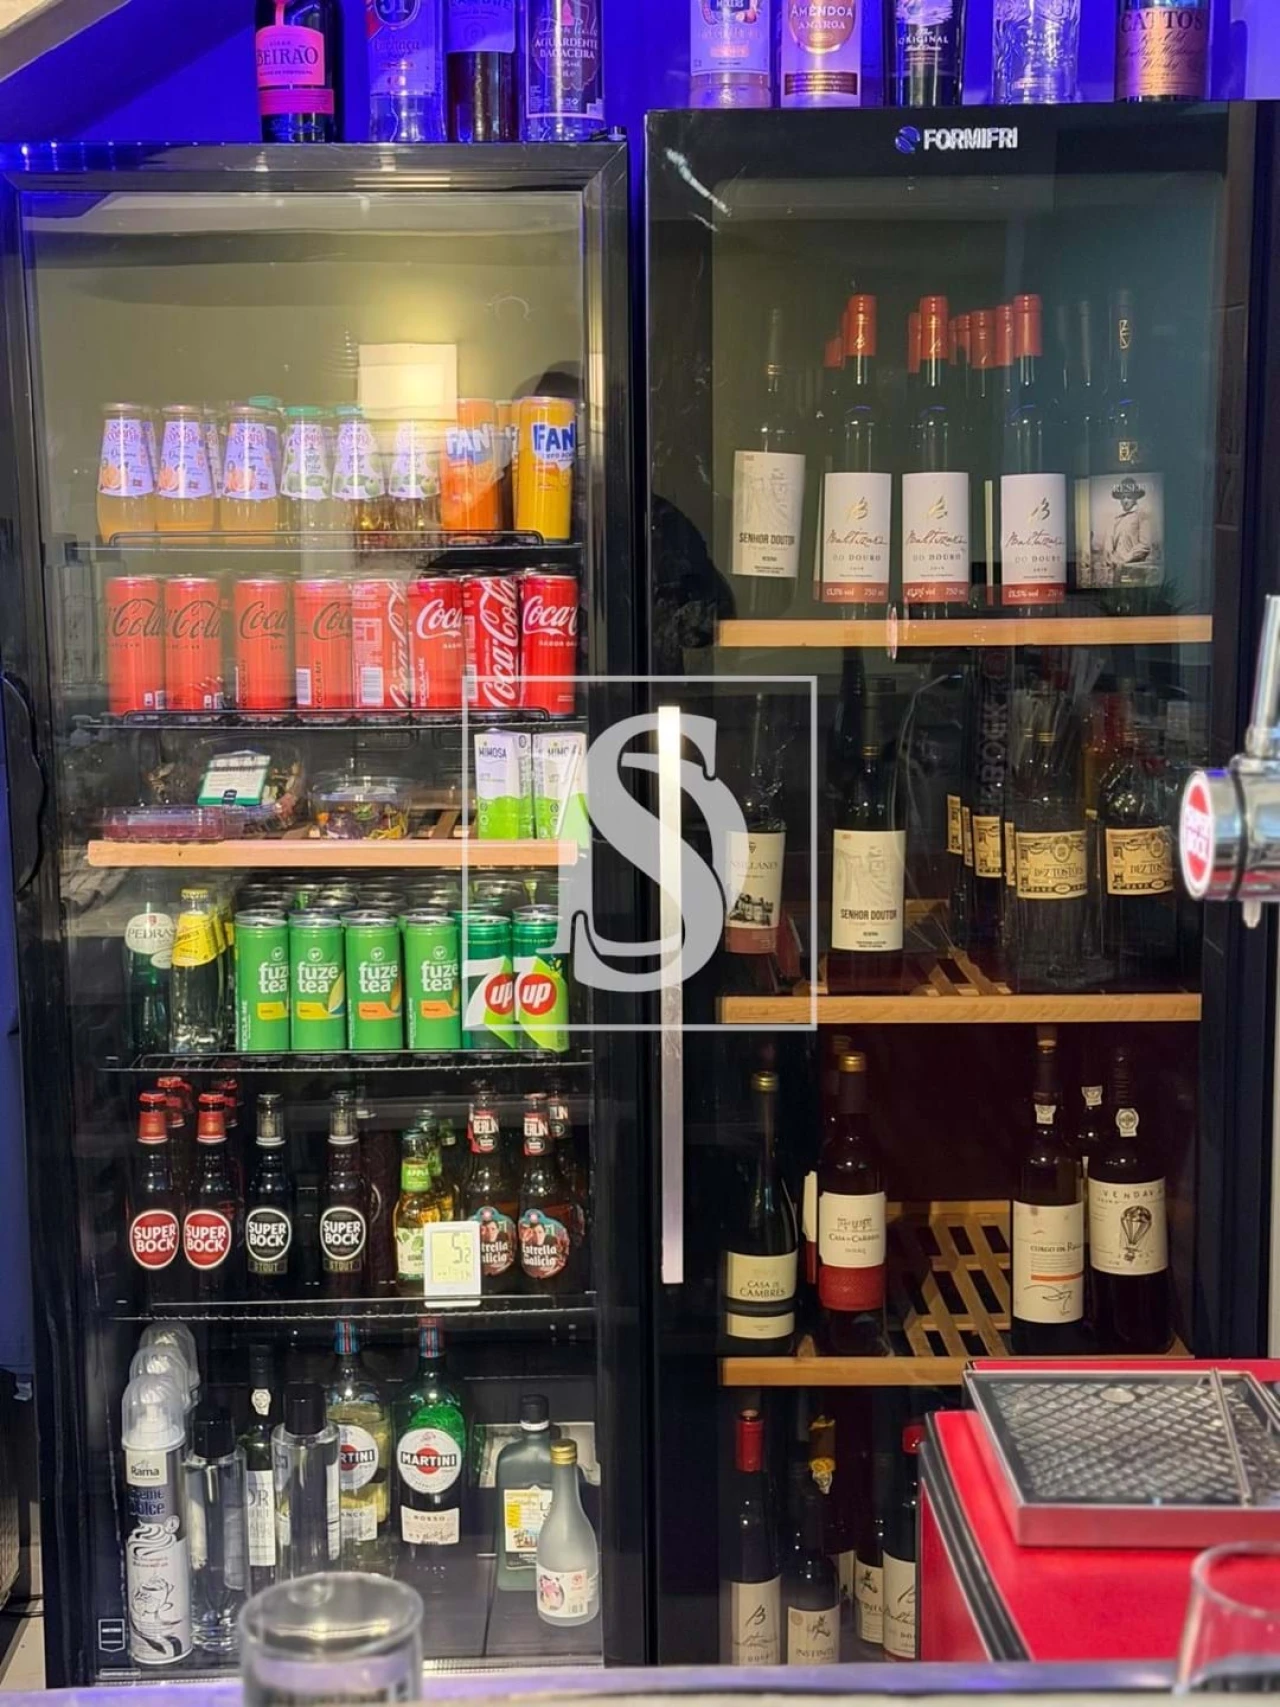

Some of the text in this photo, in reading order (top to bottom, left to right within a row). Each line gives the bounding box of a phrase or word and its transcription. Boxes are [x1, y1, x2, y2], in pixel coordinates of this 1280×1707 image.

[256, 45, 319, 67] BEIRÃO
[923, 127, 1018, 150] FORMIFRI
[739, 532, 769, 545] SENHOR
[479, 747, 508, 759] MIMOSA
[840, 908, 869, 920] SENHOR
[297, 961, 338, 981] fuze
[358, 960, 398, 980] fuze
[421, 960, 459, 980] fuze
[258, 975, 288, 994] tea
[297, 975, 329, 994] tea
[358, 974, 392, 994] tea
[421, 974, 454, 993] tea
[133, 1223, 177, 1241] SUPER
[186, 1223, 227, 1241] SUPER
[248, 1221, 287, 1235] SUPER
[323, 1220, 361, 1235] SUPER
[135, 1238, 176, 1253] BOCK
[187, 1238, 225, 1253] BOCK
[249, 1233, 285, 1247] BOCK
[324, 1232, 359, 1246] BOCK
[747, 1279, 770, 1289] CASA
[401, 1452, 456, 1466] MARTINI
[131, 1465, 160, 1476] Rama
